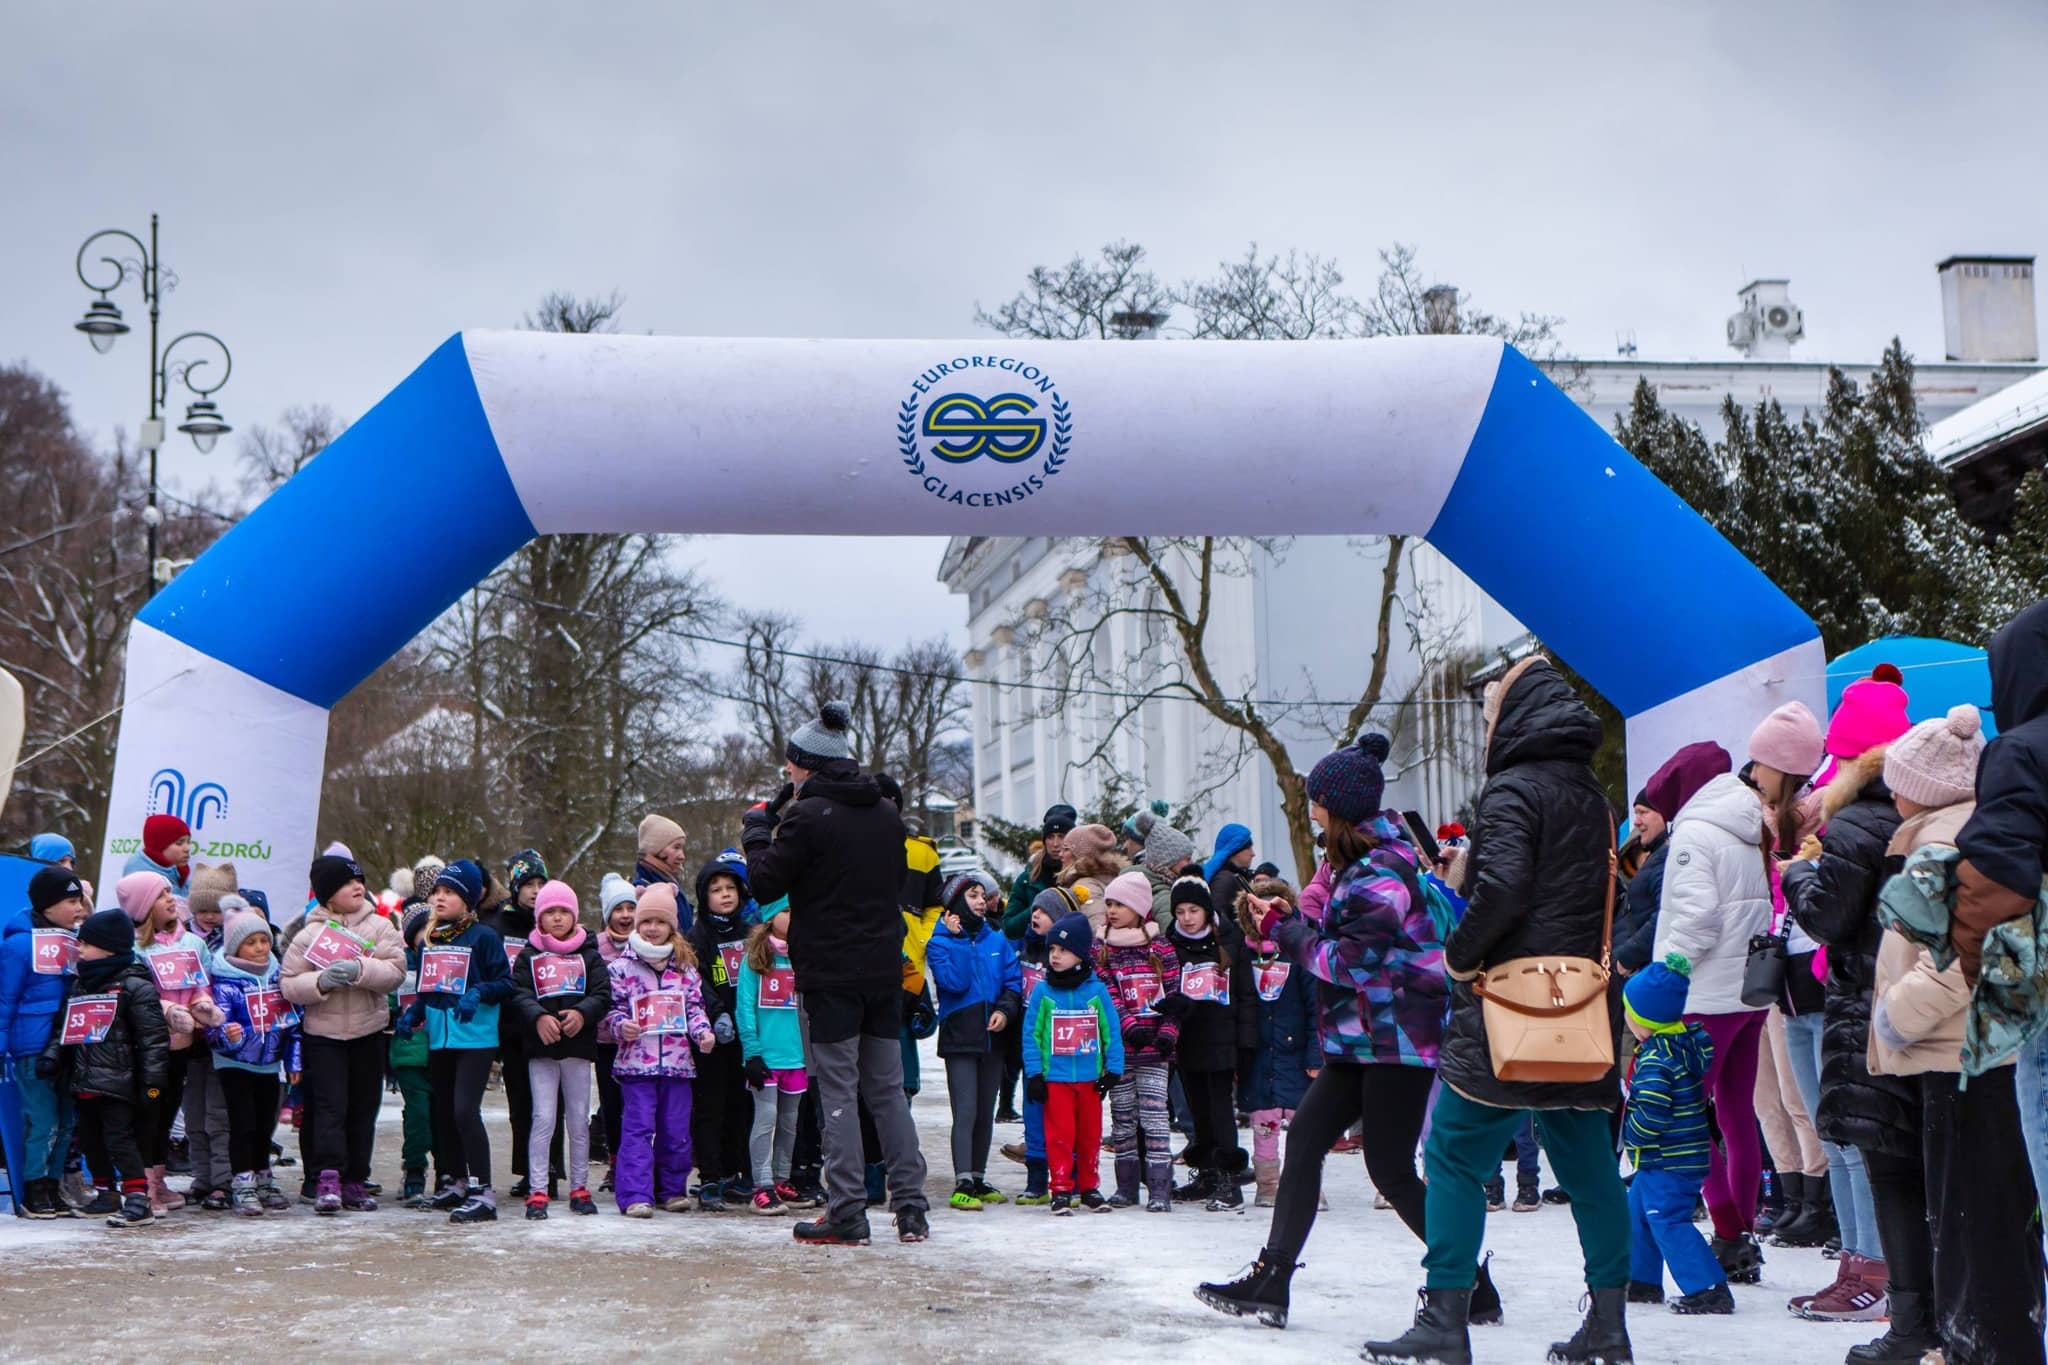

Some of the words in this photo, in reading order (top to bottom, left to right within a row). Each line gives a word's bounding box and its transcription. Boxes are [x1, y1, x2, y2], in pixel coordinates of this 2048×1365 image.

[912, 356, 1056, 394] EUROREGION
[923, 474, 1045, 507] GLACENSIS
[111, 838, 272, 860] SZCZO-ZDRÓJ
[40, 944, 60, 959] 49
[318, 936, 340, 954] 24
[157, 961, 176, 976] 29
[424, 963, 439, 977] 31
[730, 957, 739, 969] 6
[538, 965, 557, 980] 32
[769, 978, 780, 992] 8
[1186, 976, 1204, 990] 39
[1124, 988, 1138, 1001] 38
[639, 1004, 655, 1020] 34
[69, 1012, 86, 1028] 53
[1057, 1026, 1075, 1041] 17
